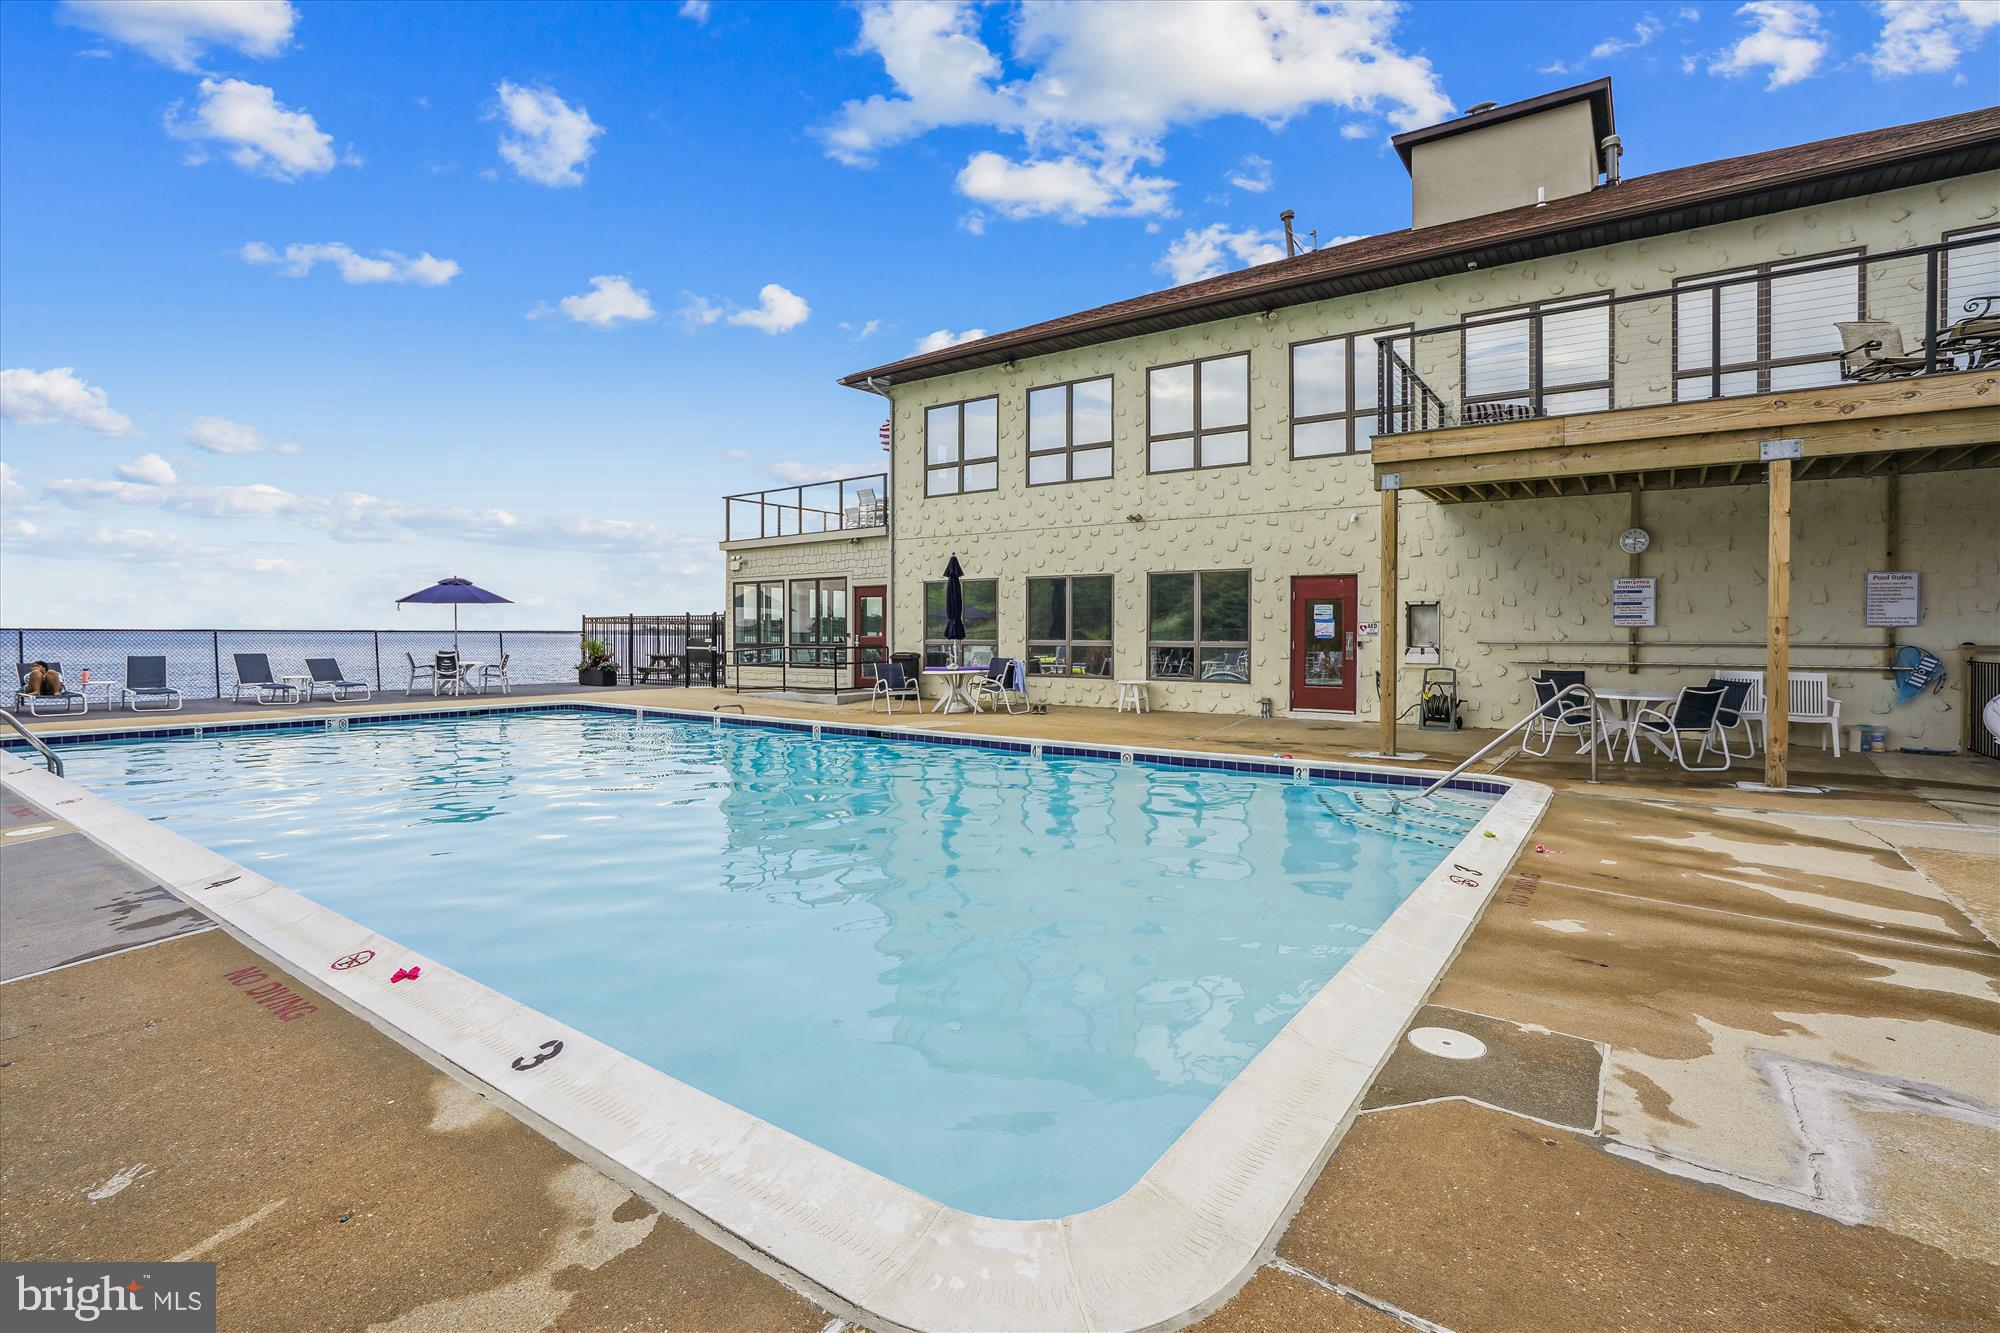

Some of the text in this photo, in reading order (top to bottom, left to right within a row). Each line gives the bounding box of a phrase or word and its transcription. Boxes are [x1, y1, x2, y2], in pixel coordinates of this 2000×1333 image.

[222, 965, 319, 1023] NO DIVING
[511, 1039, 564, 1072] 3
